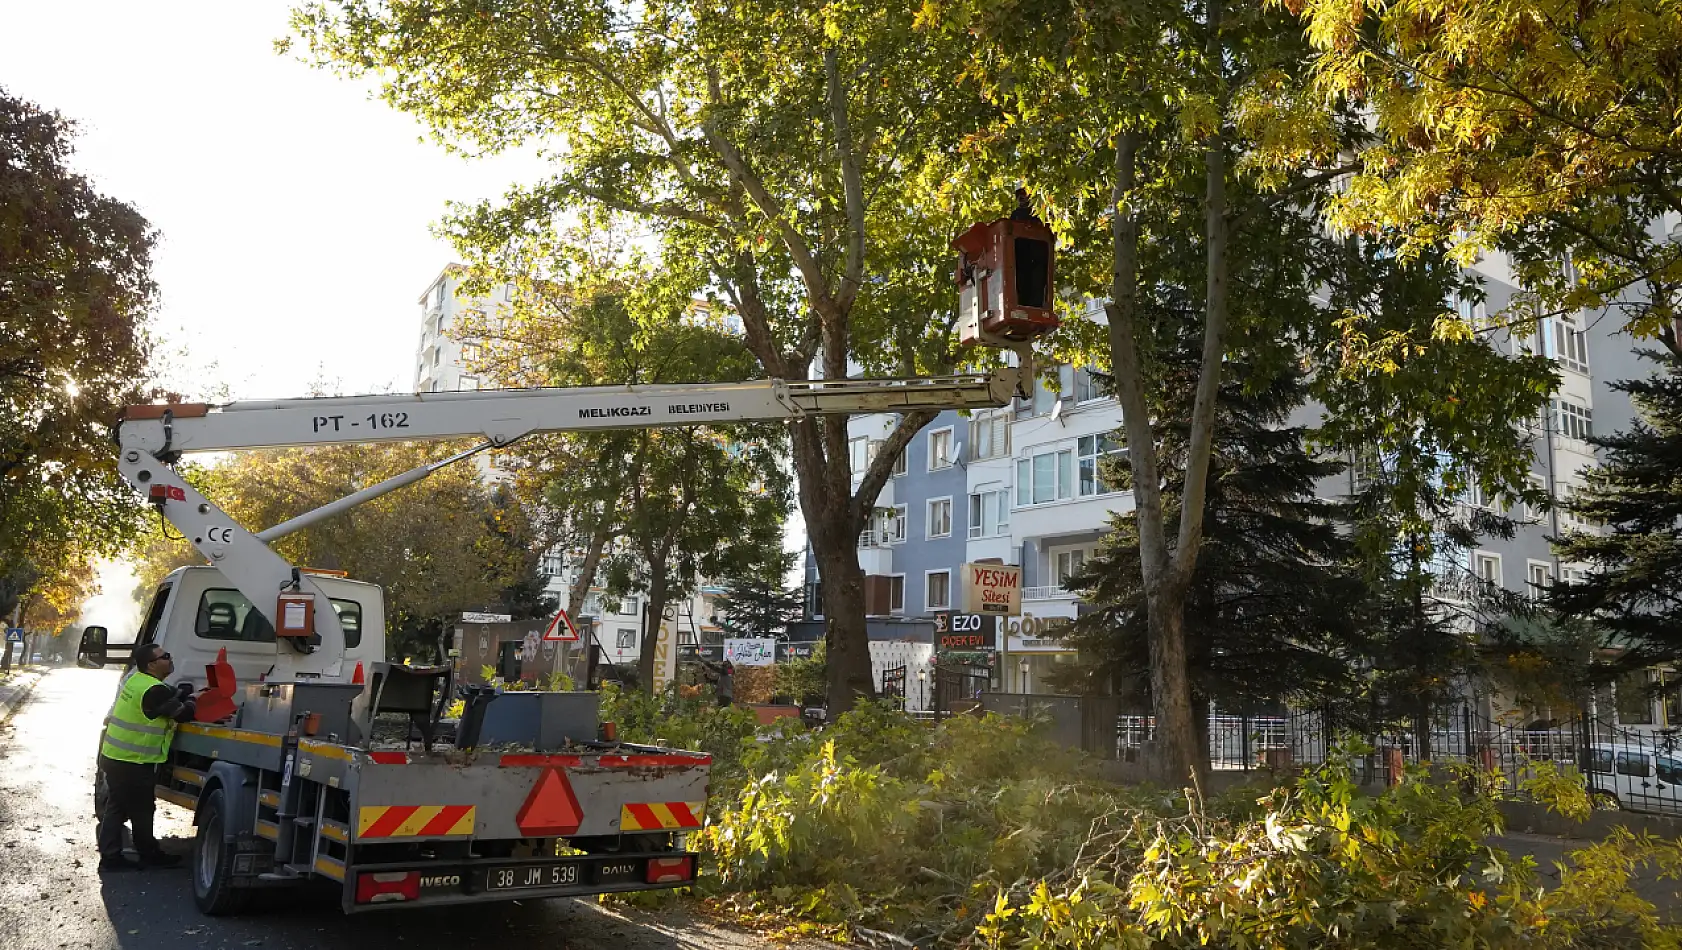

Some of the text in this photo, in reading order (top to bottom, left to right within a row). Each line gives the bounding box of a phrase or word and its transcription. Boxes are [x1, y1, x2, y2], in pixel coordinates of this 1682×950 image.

[313, 415, 344, 433] PT
[366, 412, 410, 430] 162
[208, 527, 233, 543] CE
[981, 589, 1010, 604] Sitesi
[953, 614, 981, 631] EZO
[497, 866, 575, 887] 38 JM 539
[602, 865, 635, 875] DAILY
[420, 875, 460, 887] IVECO
